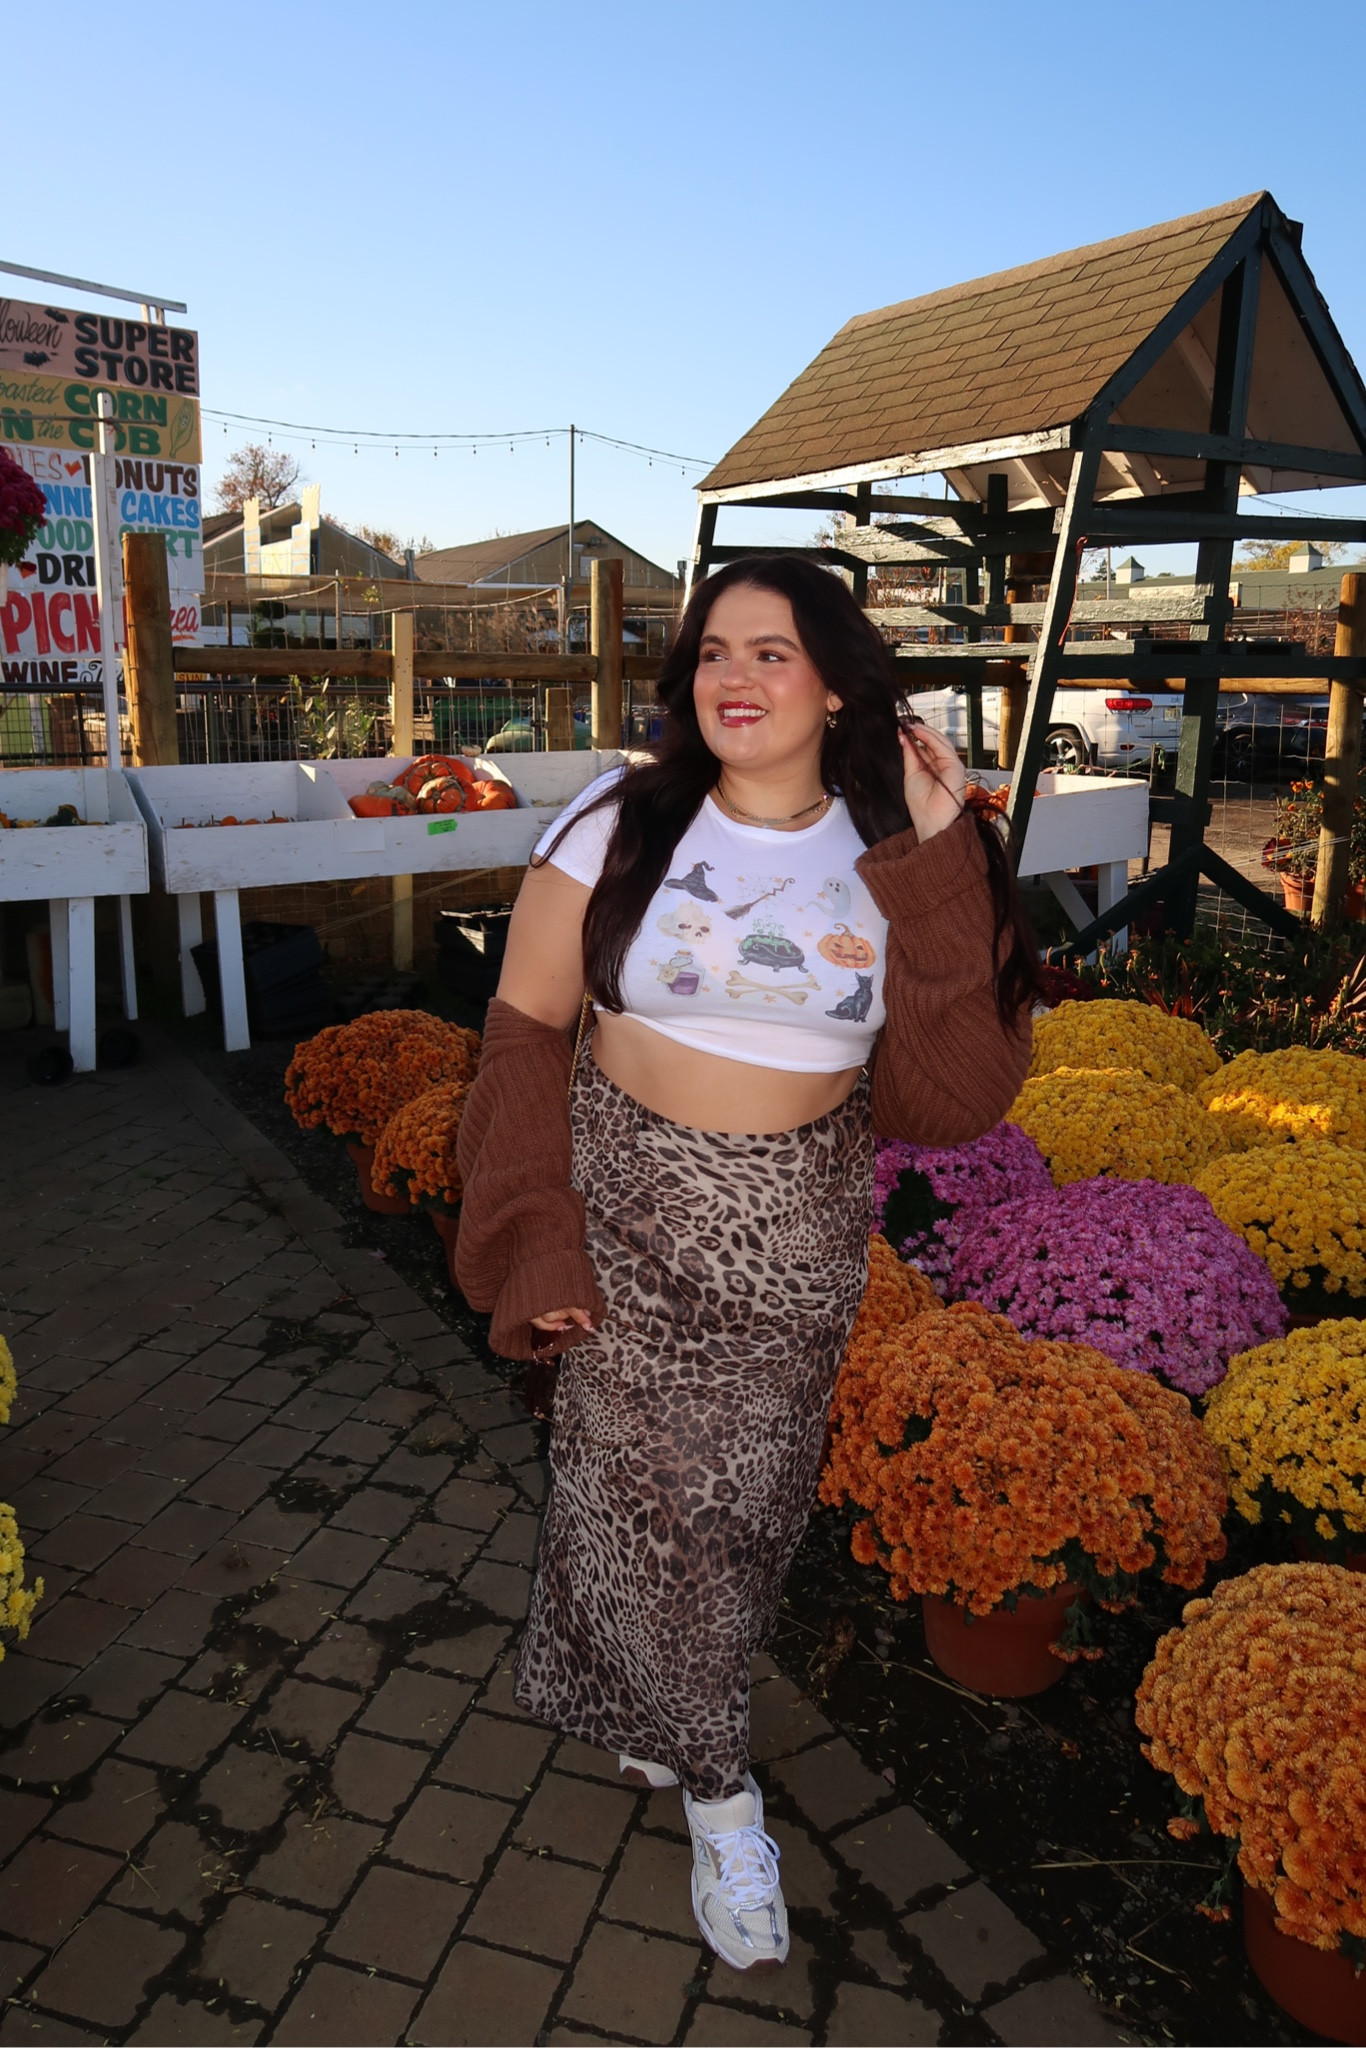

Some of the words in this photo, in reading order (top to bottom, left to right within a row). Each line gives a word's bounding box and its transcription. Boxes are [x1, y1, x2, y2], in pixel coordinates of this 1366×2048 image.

[74, 314, 195, 363] SUPER
[74, 346, 197, 394] STORE
[121, 491, 200, 529] CAKES
[36, 518, 94, 552] OOD
